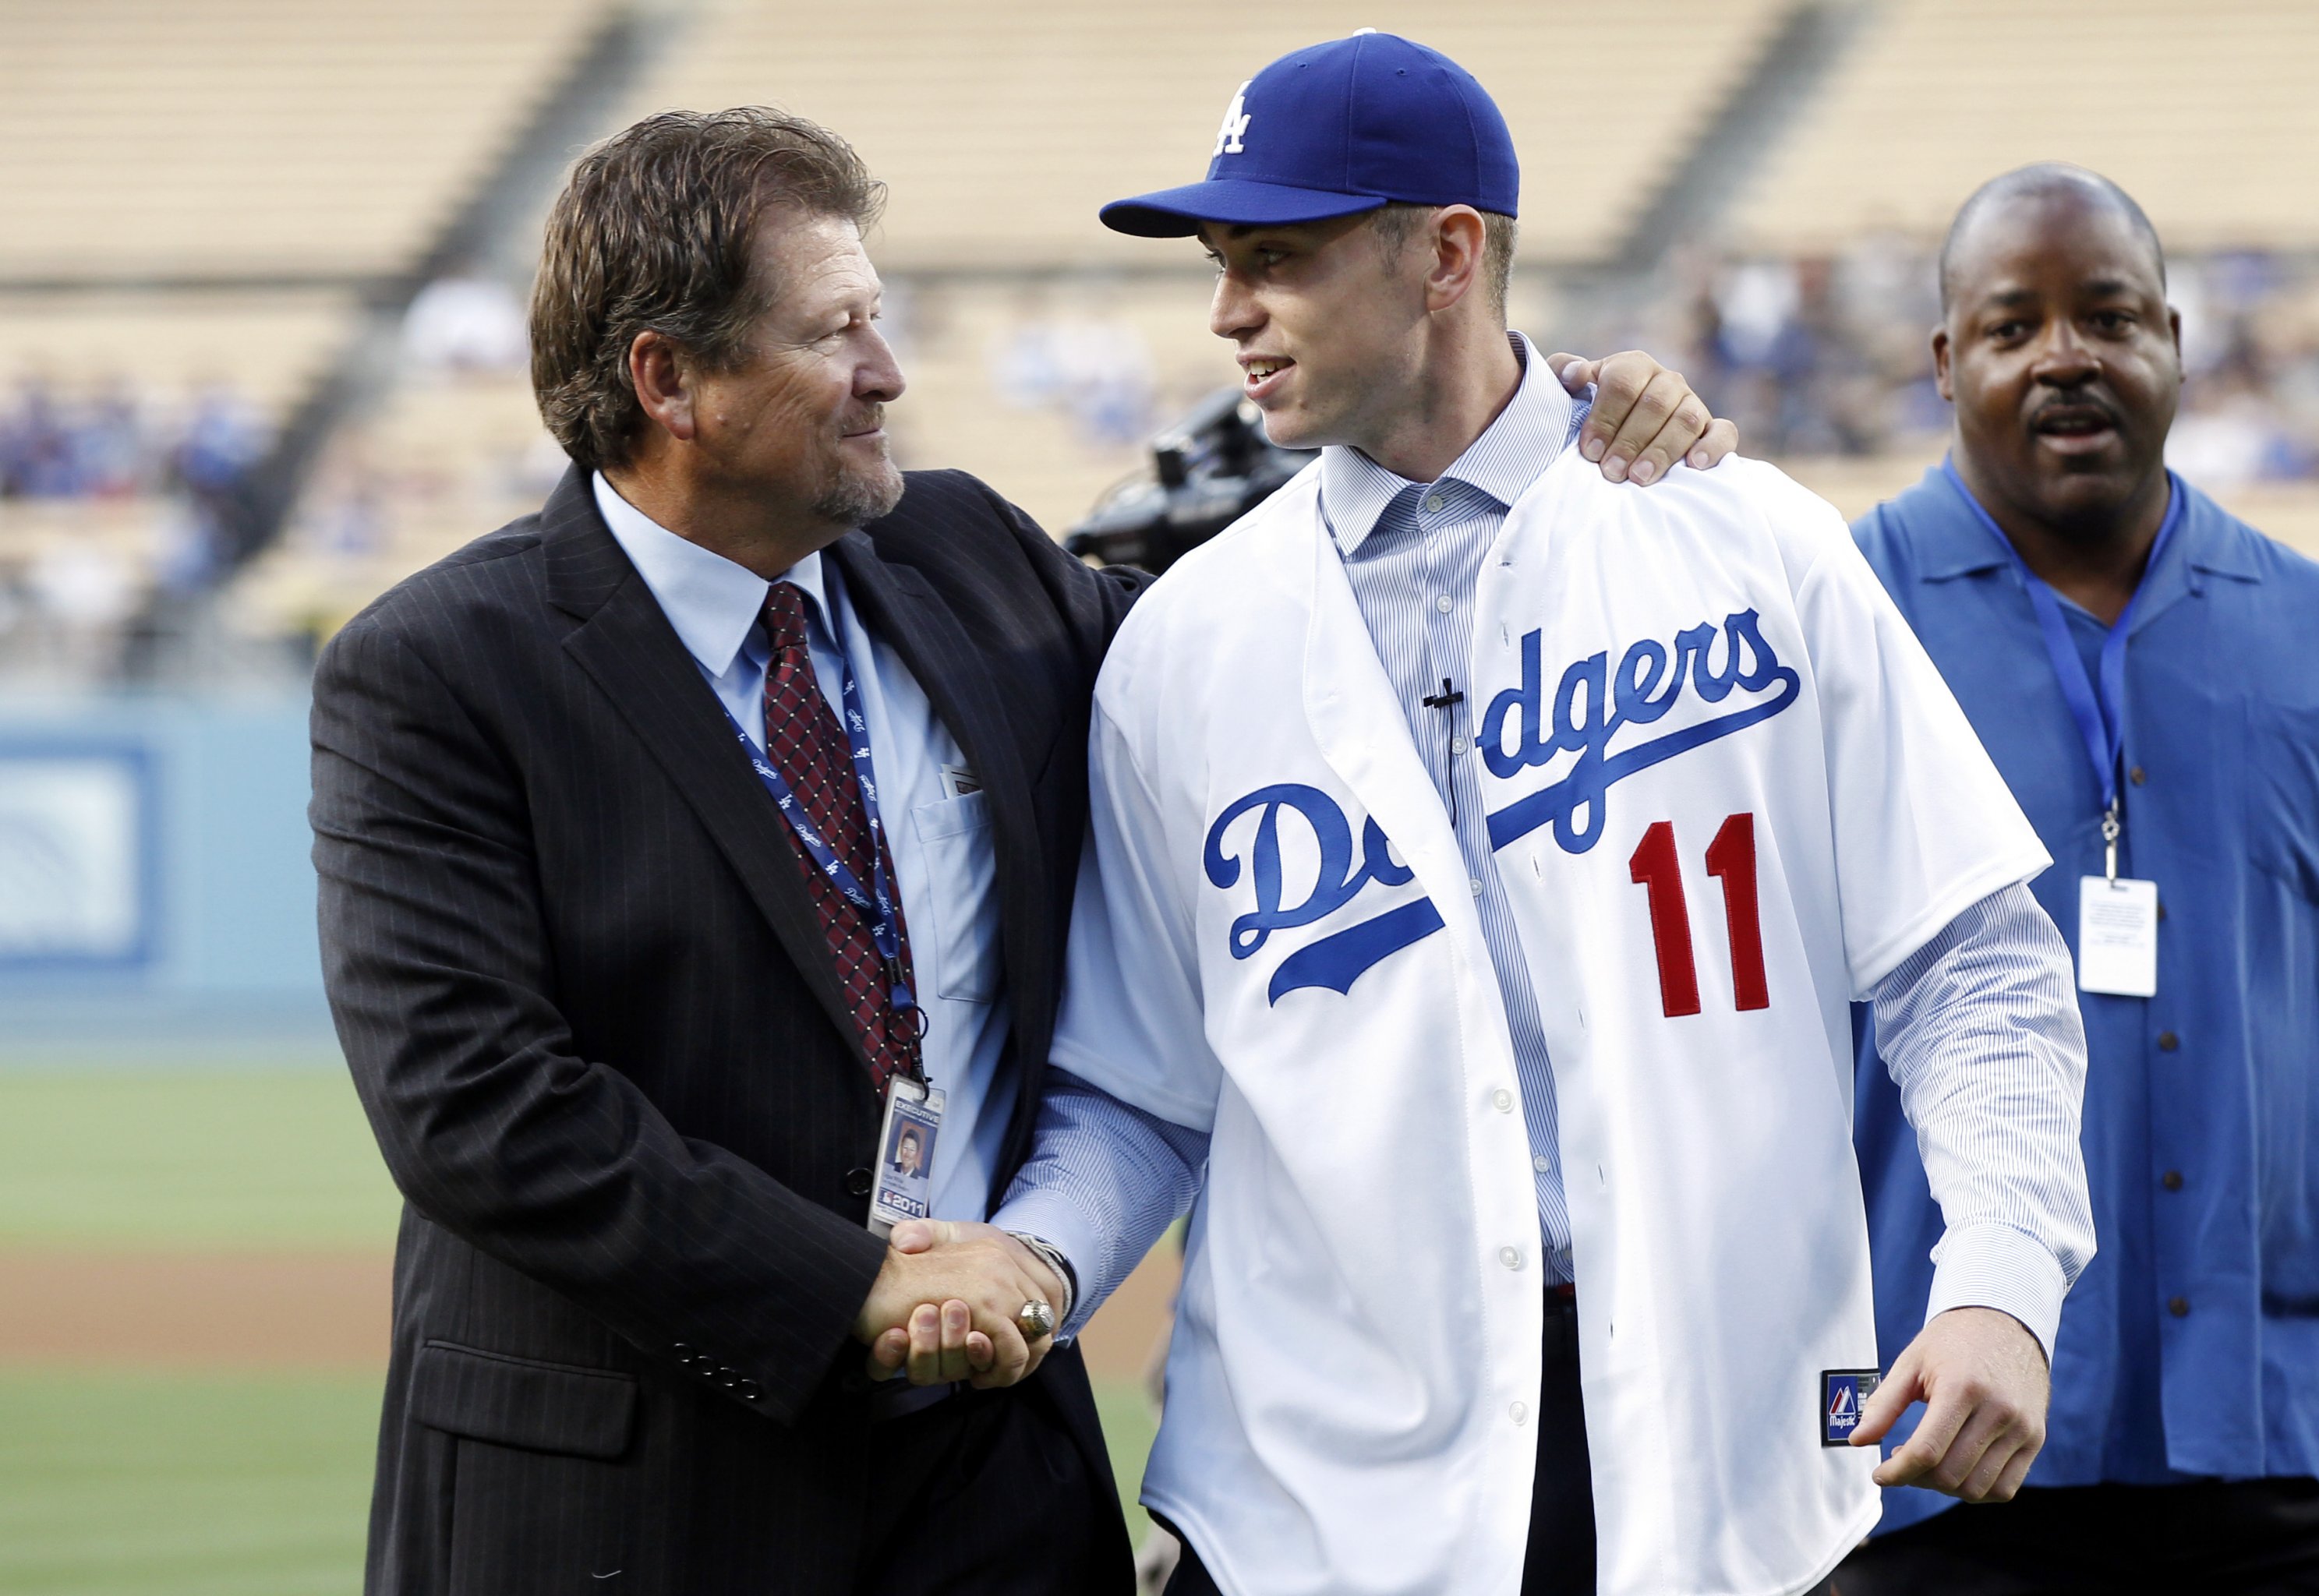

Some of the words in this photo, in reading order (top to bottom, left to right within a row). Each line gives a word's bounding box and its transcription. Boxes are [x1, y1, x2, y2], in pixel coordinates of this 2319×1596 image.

[1628, 811, 1770, 1018] 11
[895, 1099, 940, 1124] EXECUTIVE
[892, 1193, 924, 1216] 2011
[1829, 1415, 1856, 1429] Majestic
